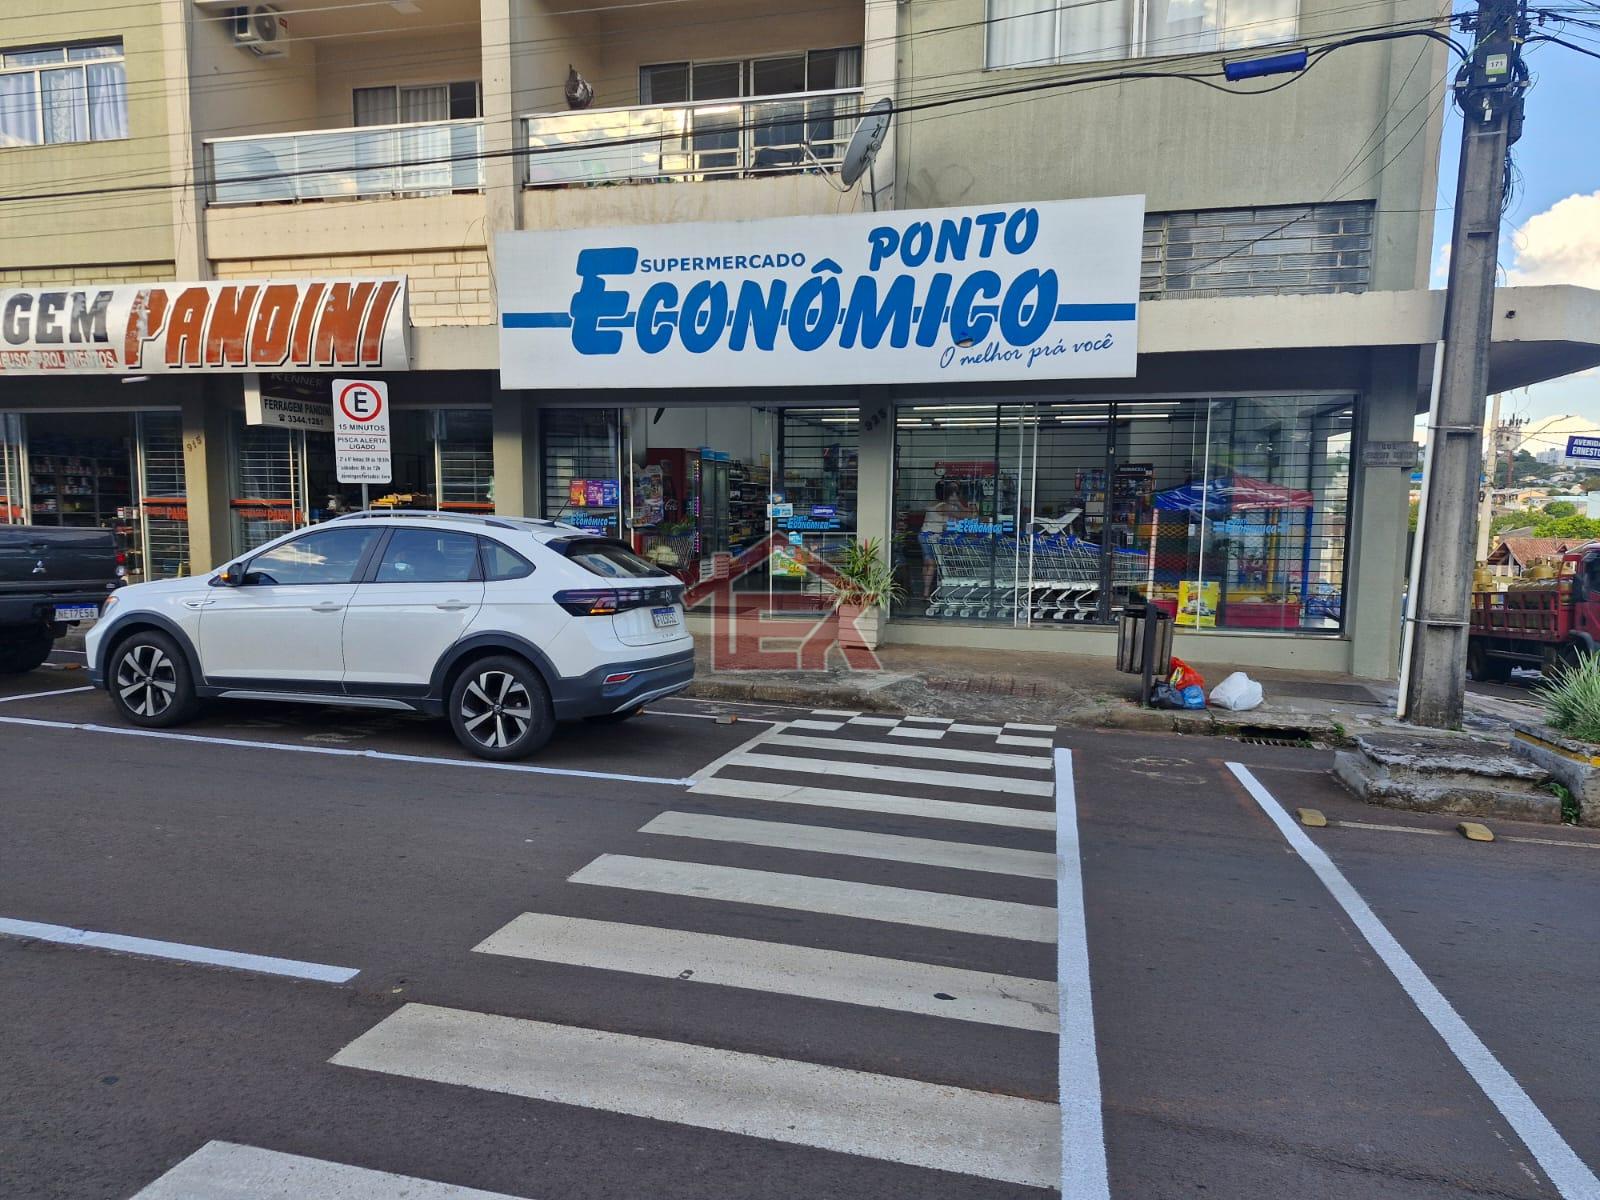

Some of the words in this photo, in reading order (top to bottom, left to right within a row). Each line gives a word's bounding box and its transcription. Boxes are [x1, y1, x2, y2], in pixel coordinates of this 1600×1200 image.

[867, 206, 1038, 271] PONTO
[640, 253, 806, 274] SUPERMERCADO
[2, 290, 114, 345] GEM
[570, 246, 1058, 355] ECONÔMICO
[124, 280, 401, 368] PANDINI
[939, 345, 957, 369] O
[958, 342, 1024, 367] melhor
[1026, 339, 1065, 368] prá
[1072, 332, 1113, 353] você
[264, 398, 303, 412] FERRAGEM
[354, 391, 369, 413] E
[338, 423, 347, 431] 15
[349, 423, 386, 432] MINUTOS
